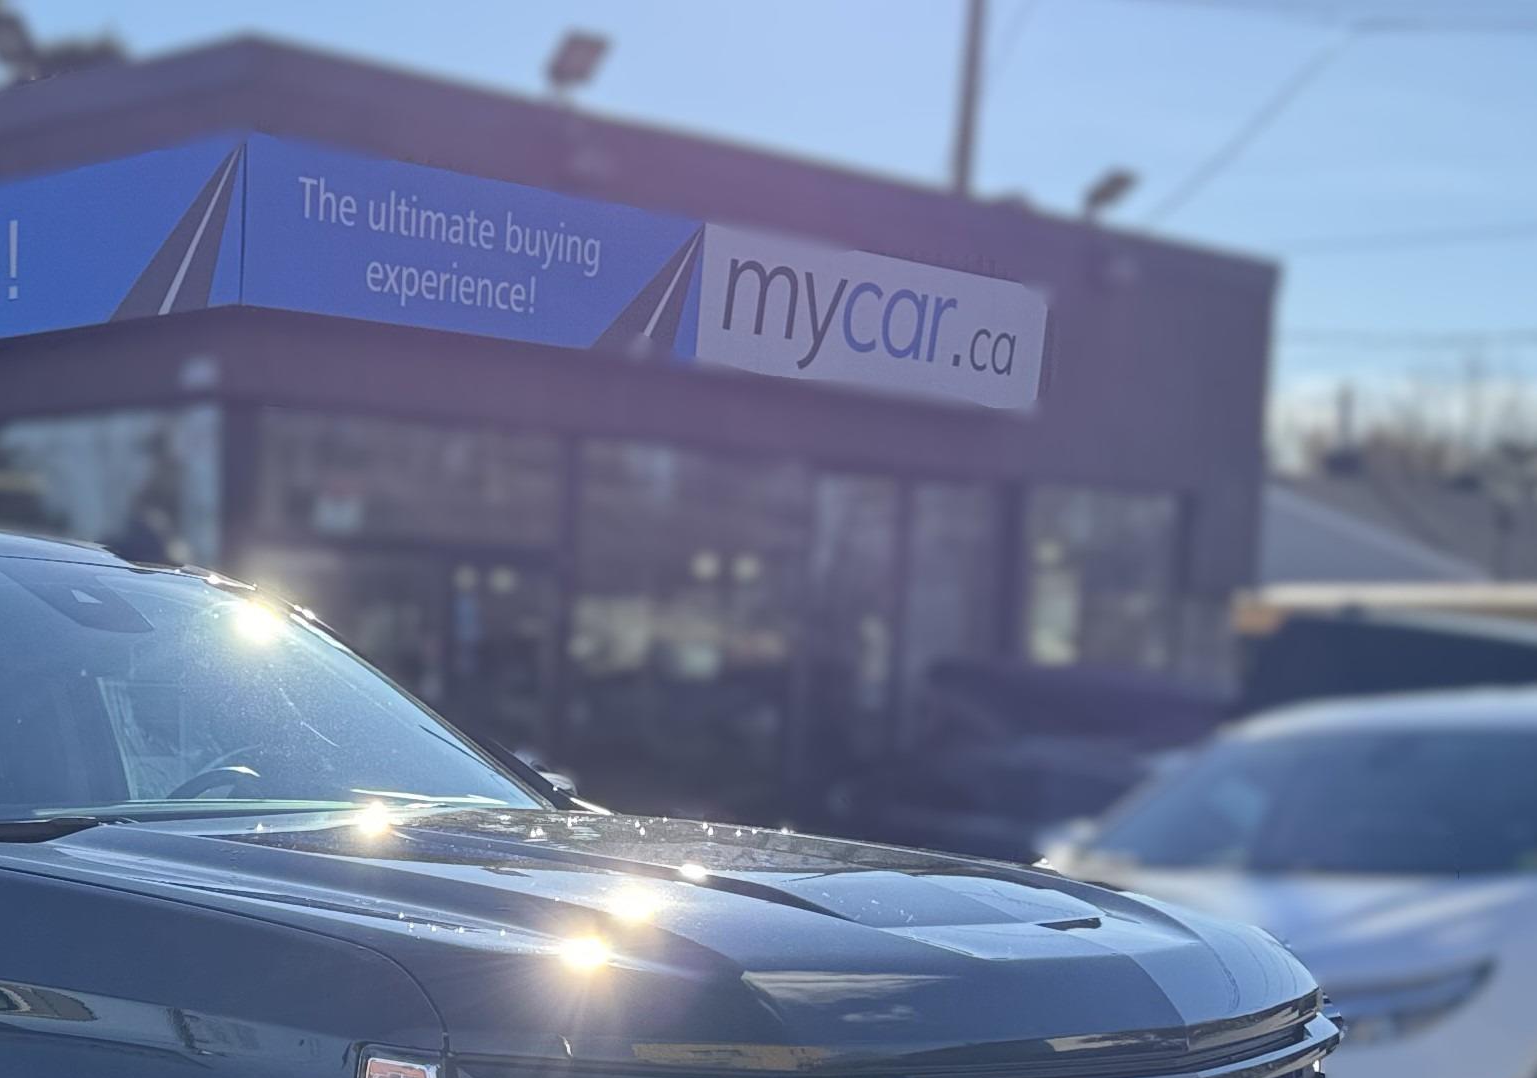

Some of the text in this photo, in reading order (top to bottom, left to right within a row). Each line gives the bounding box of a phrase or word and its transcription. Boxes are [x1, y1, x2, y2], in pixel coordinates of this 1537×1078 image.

[297, 175, 602, 278] The ultimate buying
[365, 260, 536, 314] experience!
[721, 257, 1017, 377] mycar.ca
